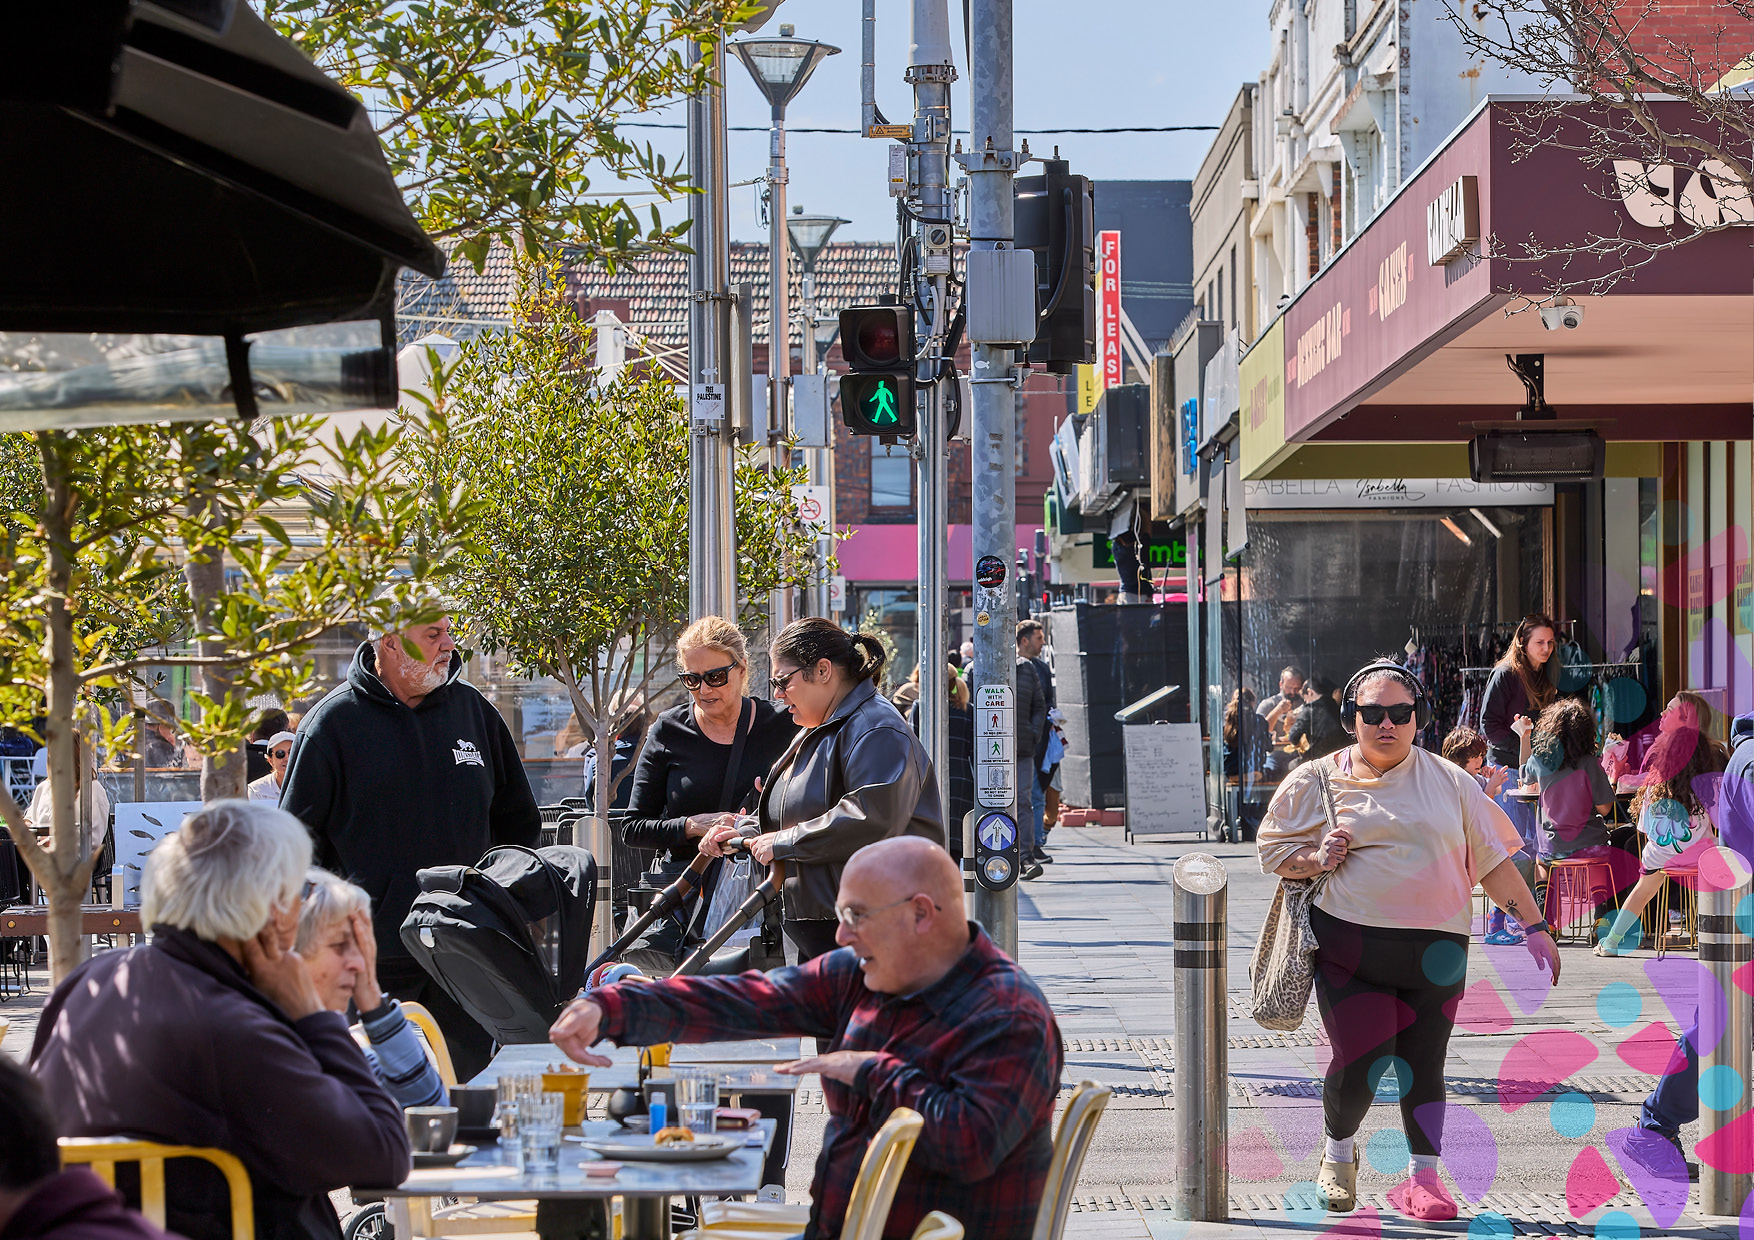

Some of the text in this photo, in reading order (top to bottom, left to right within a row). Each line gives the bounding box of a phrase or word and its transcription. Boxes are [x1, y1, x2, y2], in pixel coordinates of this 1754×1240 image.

[1105, 241, 1116, 292] FOR
[1378, 240, 1407, 322] CAKES
[1326, 301, 1342, 364] BAR
[696, 392, 722, 400] PALESTINE
